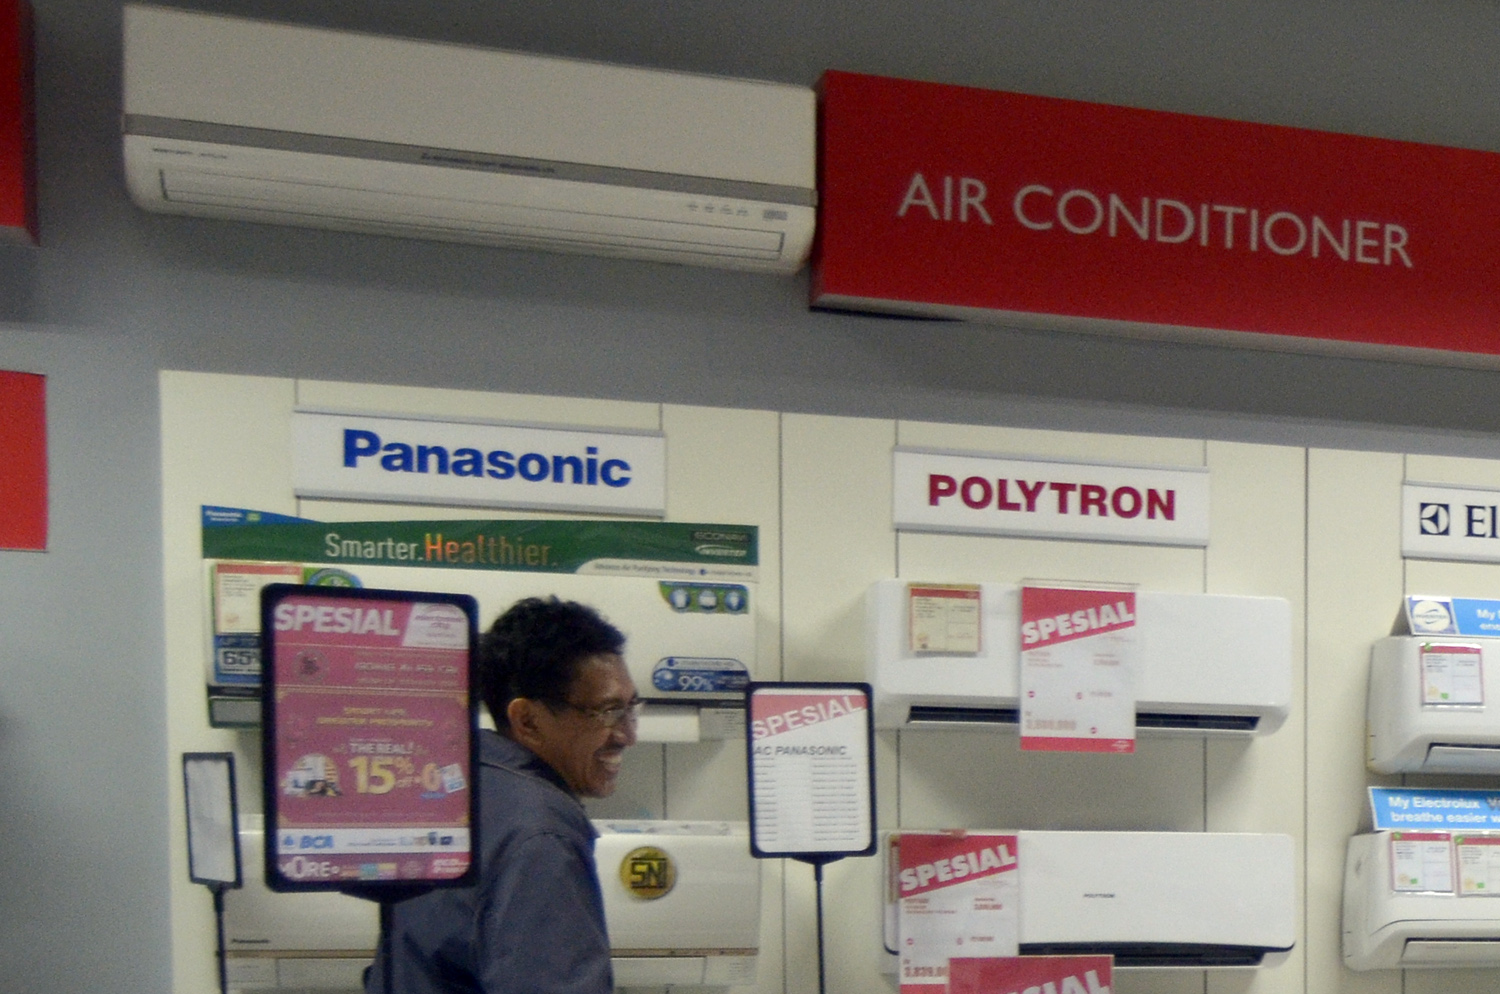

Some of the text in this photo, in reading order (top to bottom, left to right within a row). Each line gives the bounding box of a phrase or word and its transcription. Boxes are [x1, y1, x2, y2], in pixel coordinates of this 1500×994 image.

[898, 172, 1414, 269] AIR CONDITIONER
[343, 428, 632, 489] Panasonic
[928, 473, 1176, 521] POLYTRON
[273, 602, 401, 636] SPESIAL
[1021, 600, 1135, 645] SPESIAL
[1476, 608, 1496, 621] My
[752, 695, 864, 741] SPESIAL
[754, 745, 848, 756] AC PANASONIC
[1388, 796, 1410, 810] My
[1412, 796, 1481, 809] Electrolux
[1390, 811, 1444, 823] breathe
[1445, 812, 1488, 823] easier
[900, 843, 1017, 892] SPESIAL
